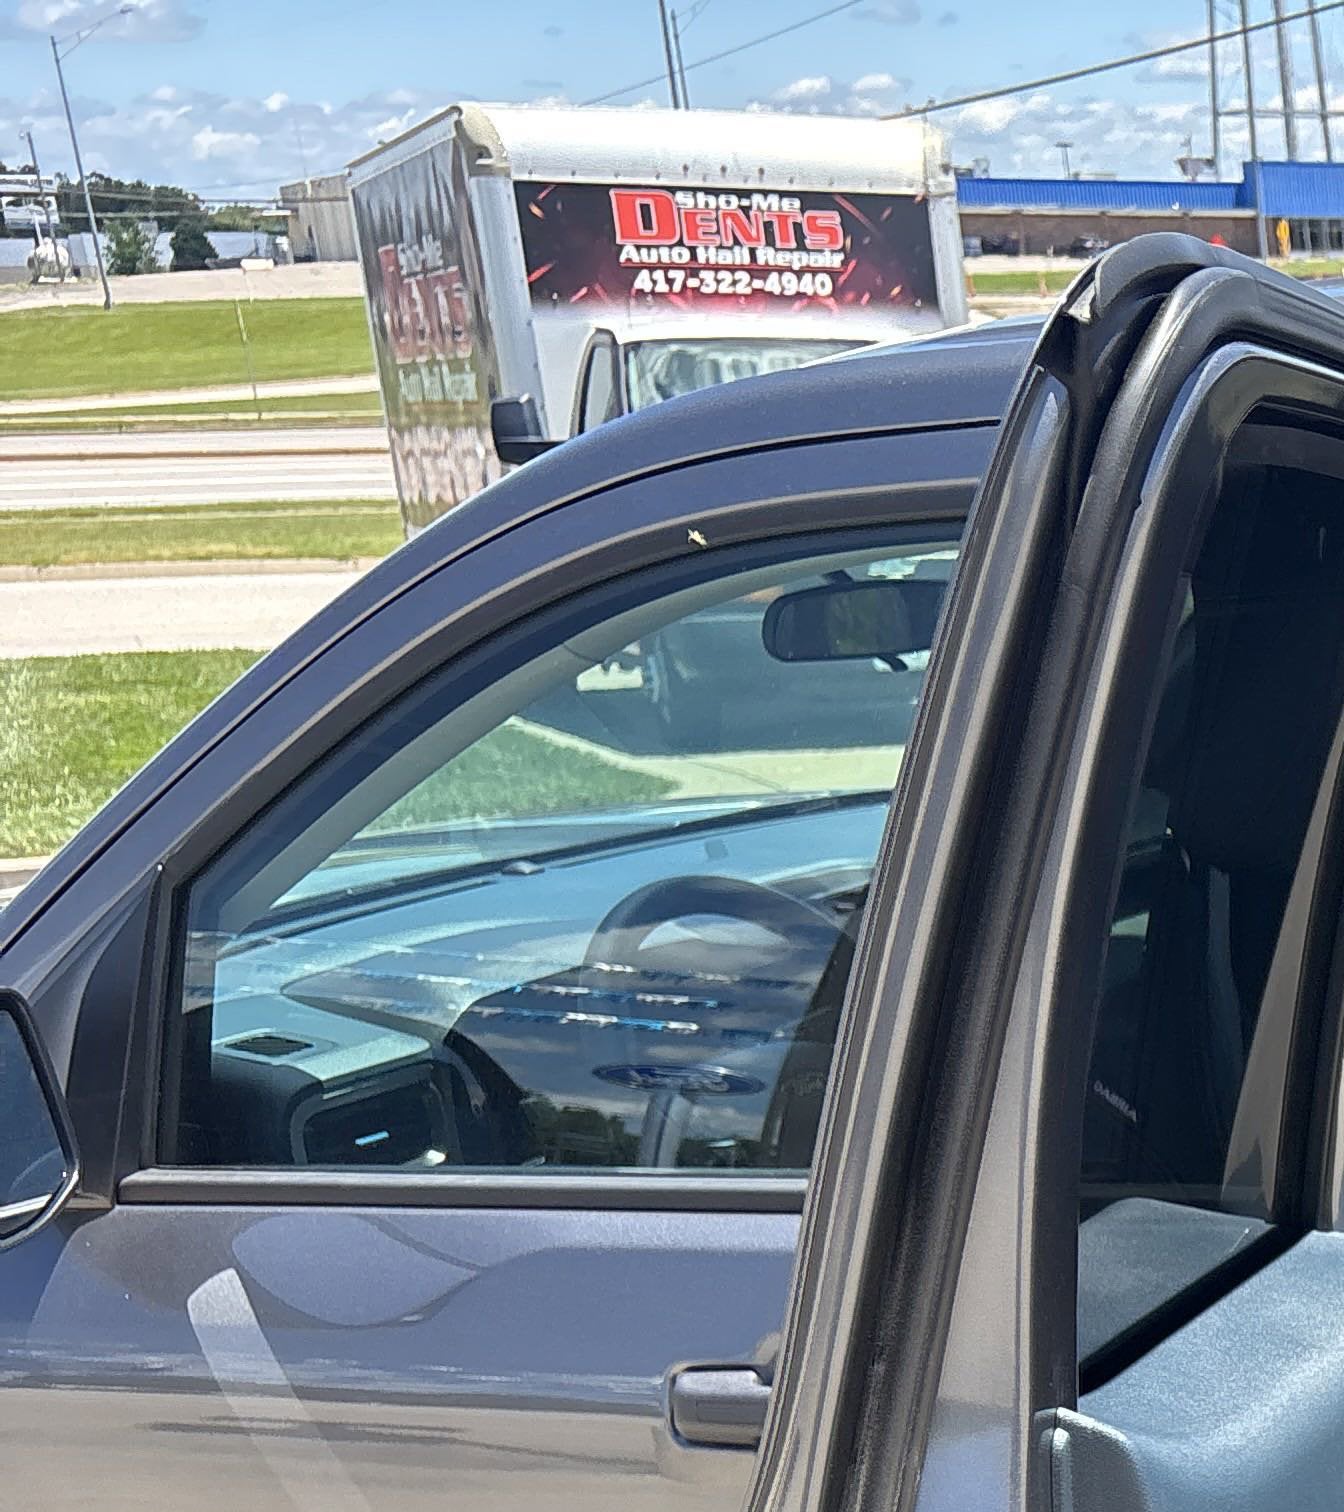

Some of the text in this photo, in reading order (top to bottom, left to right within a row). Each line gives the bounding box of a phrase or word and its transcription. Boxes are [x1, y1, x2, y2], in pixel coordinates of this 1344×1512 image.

[675, 191, 800, 211] Sho-Me
[610, 189, 844, 249] DENTS
[619, 245, 845, 270] Auto Hail Repair
[633, 269, 833, 296] 417-322-4940
